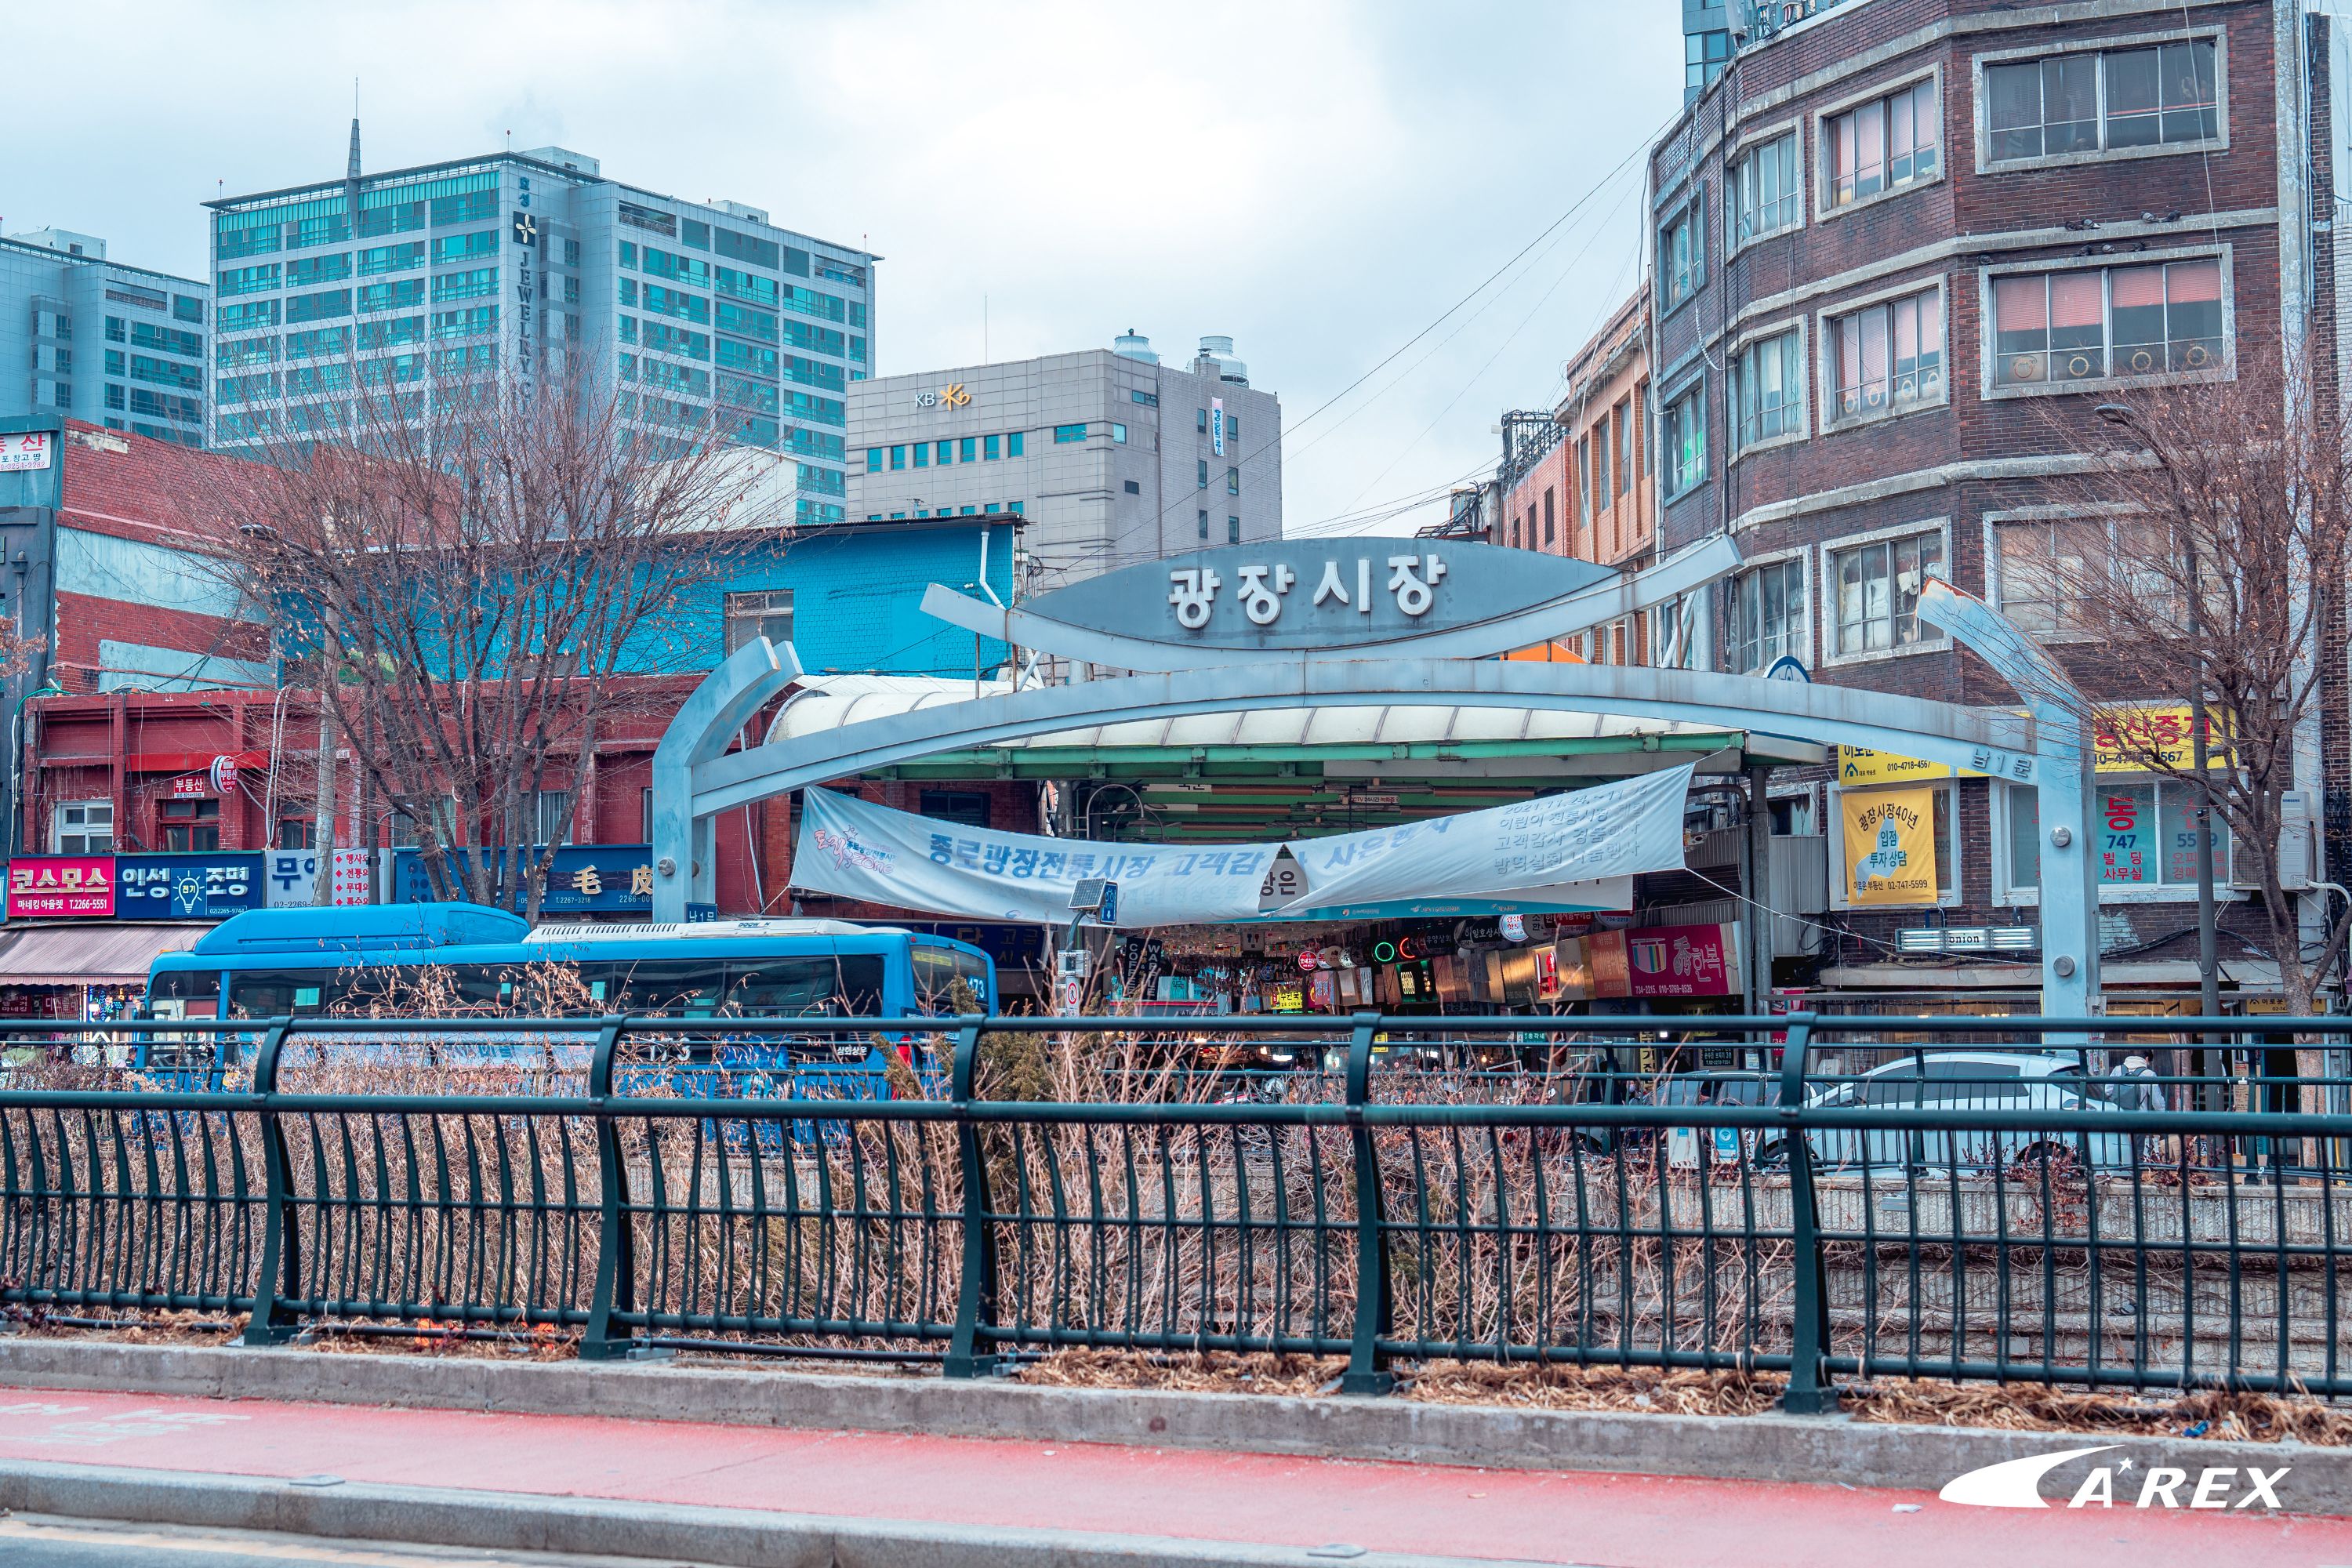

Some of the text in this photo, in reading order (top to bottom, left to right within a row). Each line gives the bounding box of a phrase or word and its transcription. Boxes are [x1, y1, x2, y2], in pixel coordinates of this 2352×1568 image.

[517, 252, 533, 373] JEWELRY
[915, 392, 935, 408] KB
[1168, 553, 1446, 630] 광장시장
[175, 778, 204, 793] 부동산
[2104, 797, 2138, 831] 동
[1499, 814, 1544, 831] 어린이
[1880, 829, 1897, 848] 입점
[2106, 832, 2219, 849] 747 559
[1869, 850, 1907, 869] 투자 상담
[2172, 850, 2226, 864] 오피텔
[10, 867, 110, 894] 코스모스
[122, 866, 249, 898] 인성 조명
[2103, 867, 2143, 881] 사무실
[182, 884, 197, 894] 전기
[1853, 879, 1928, 891] 이로운 부동산 02-747-5599
[17, 899, 40, 910] 마네킹
[69, 898, 107, 909] T.2266-5551
[274, 900, 314, 909] 02-2269-
[1948, 933, 1980, 943] onion
